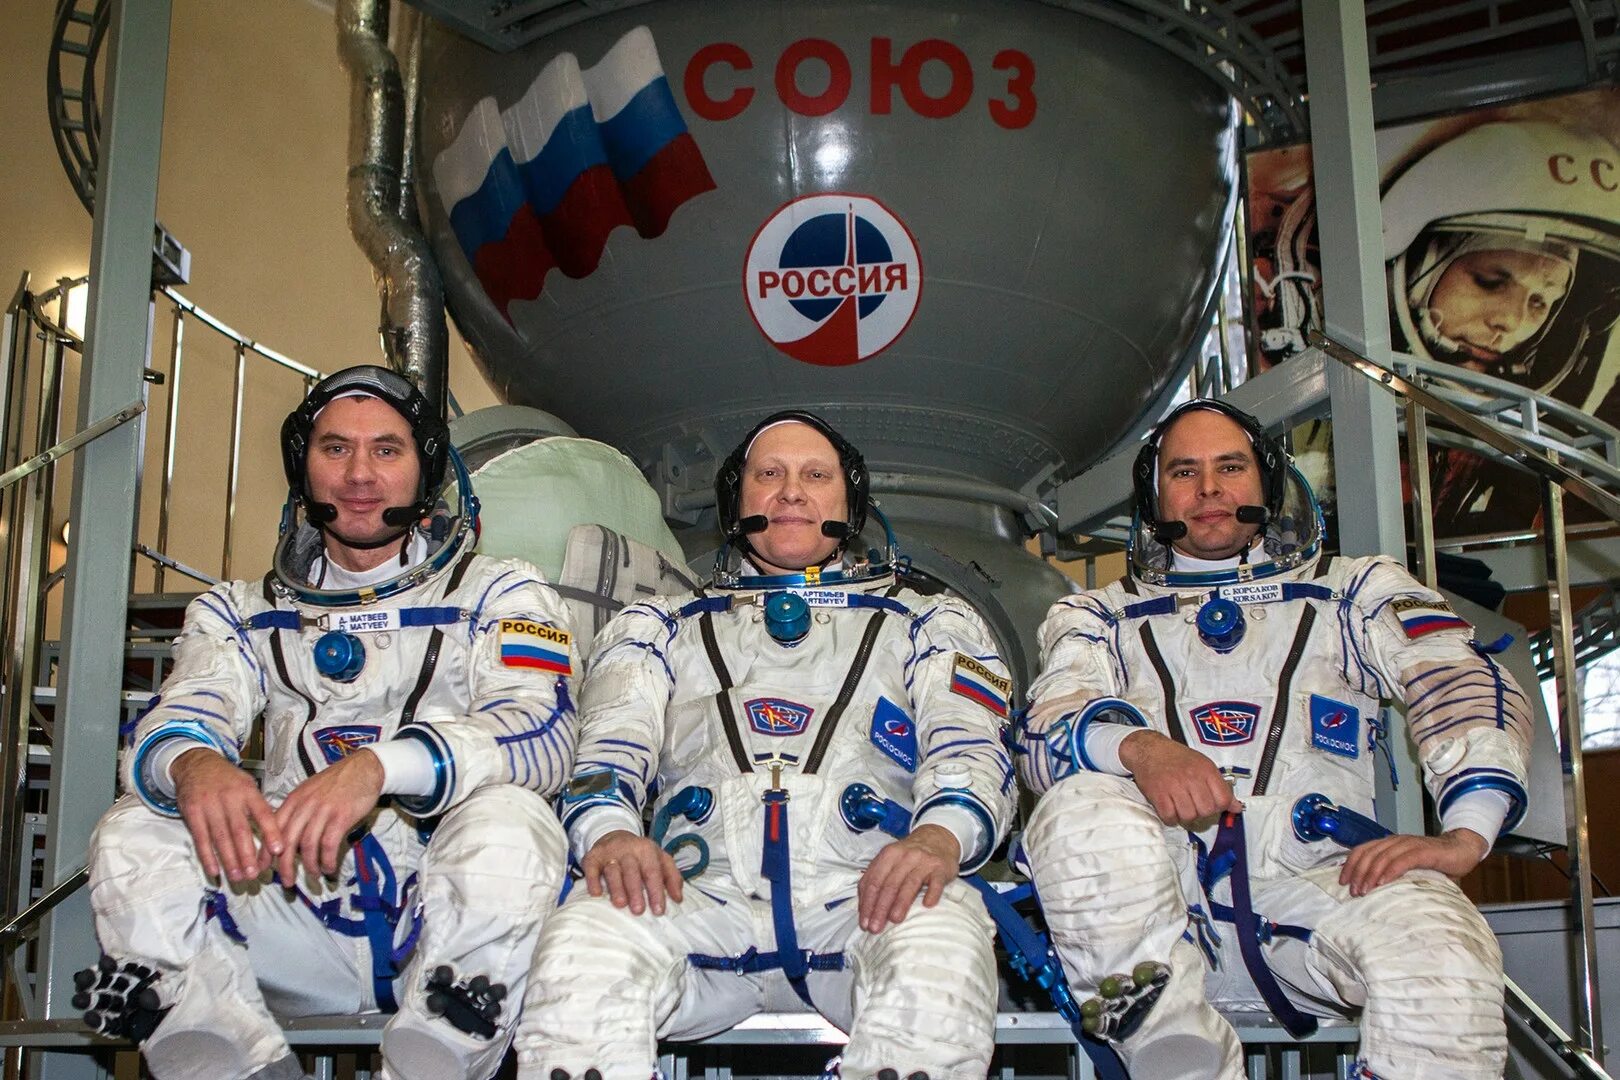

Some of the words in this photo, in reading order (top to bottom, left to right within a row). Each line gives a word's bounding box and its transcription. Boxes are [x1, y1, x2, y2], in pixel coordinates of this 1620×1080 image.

[684, 36, 1038, 130] СОЮЗ
[758, 263, 908, 299] РОССИЯ
[350, 613, 388, 623] МАТВЕЕВ
[350, 621, 388, 631] MATVEEV
[502, 621, 569, 645] РОССИЯ
[957, 656, 1009, 691] РОССИЯ
